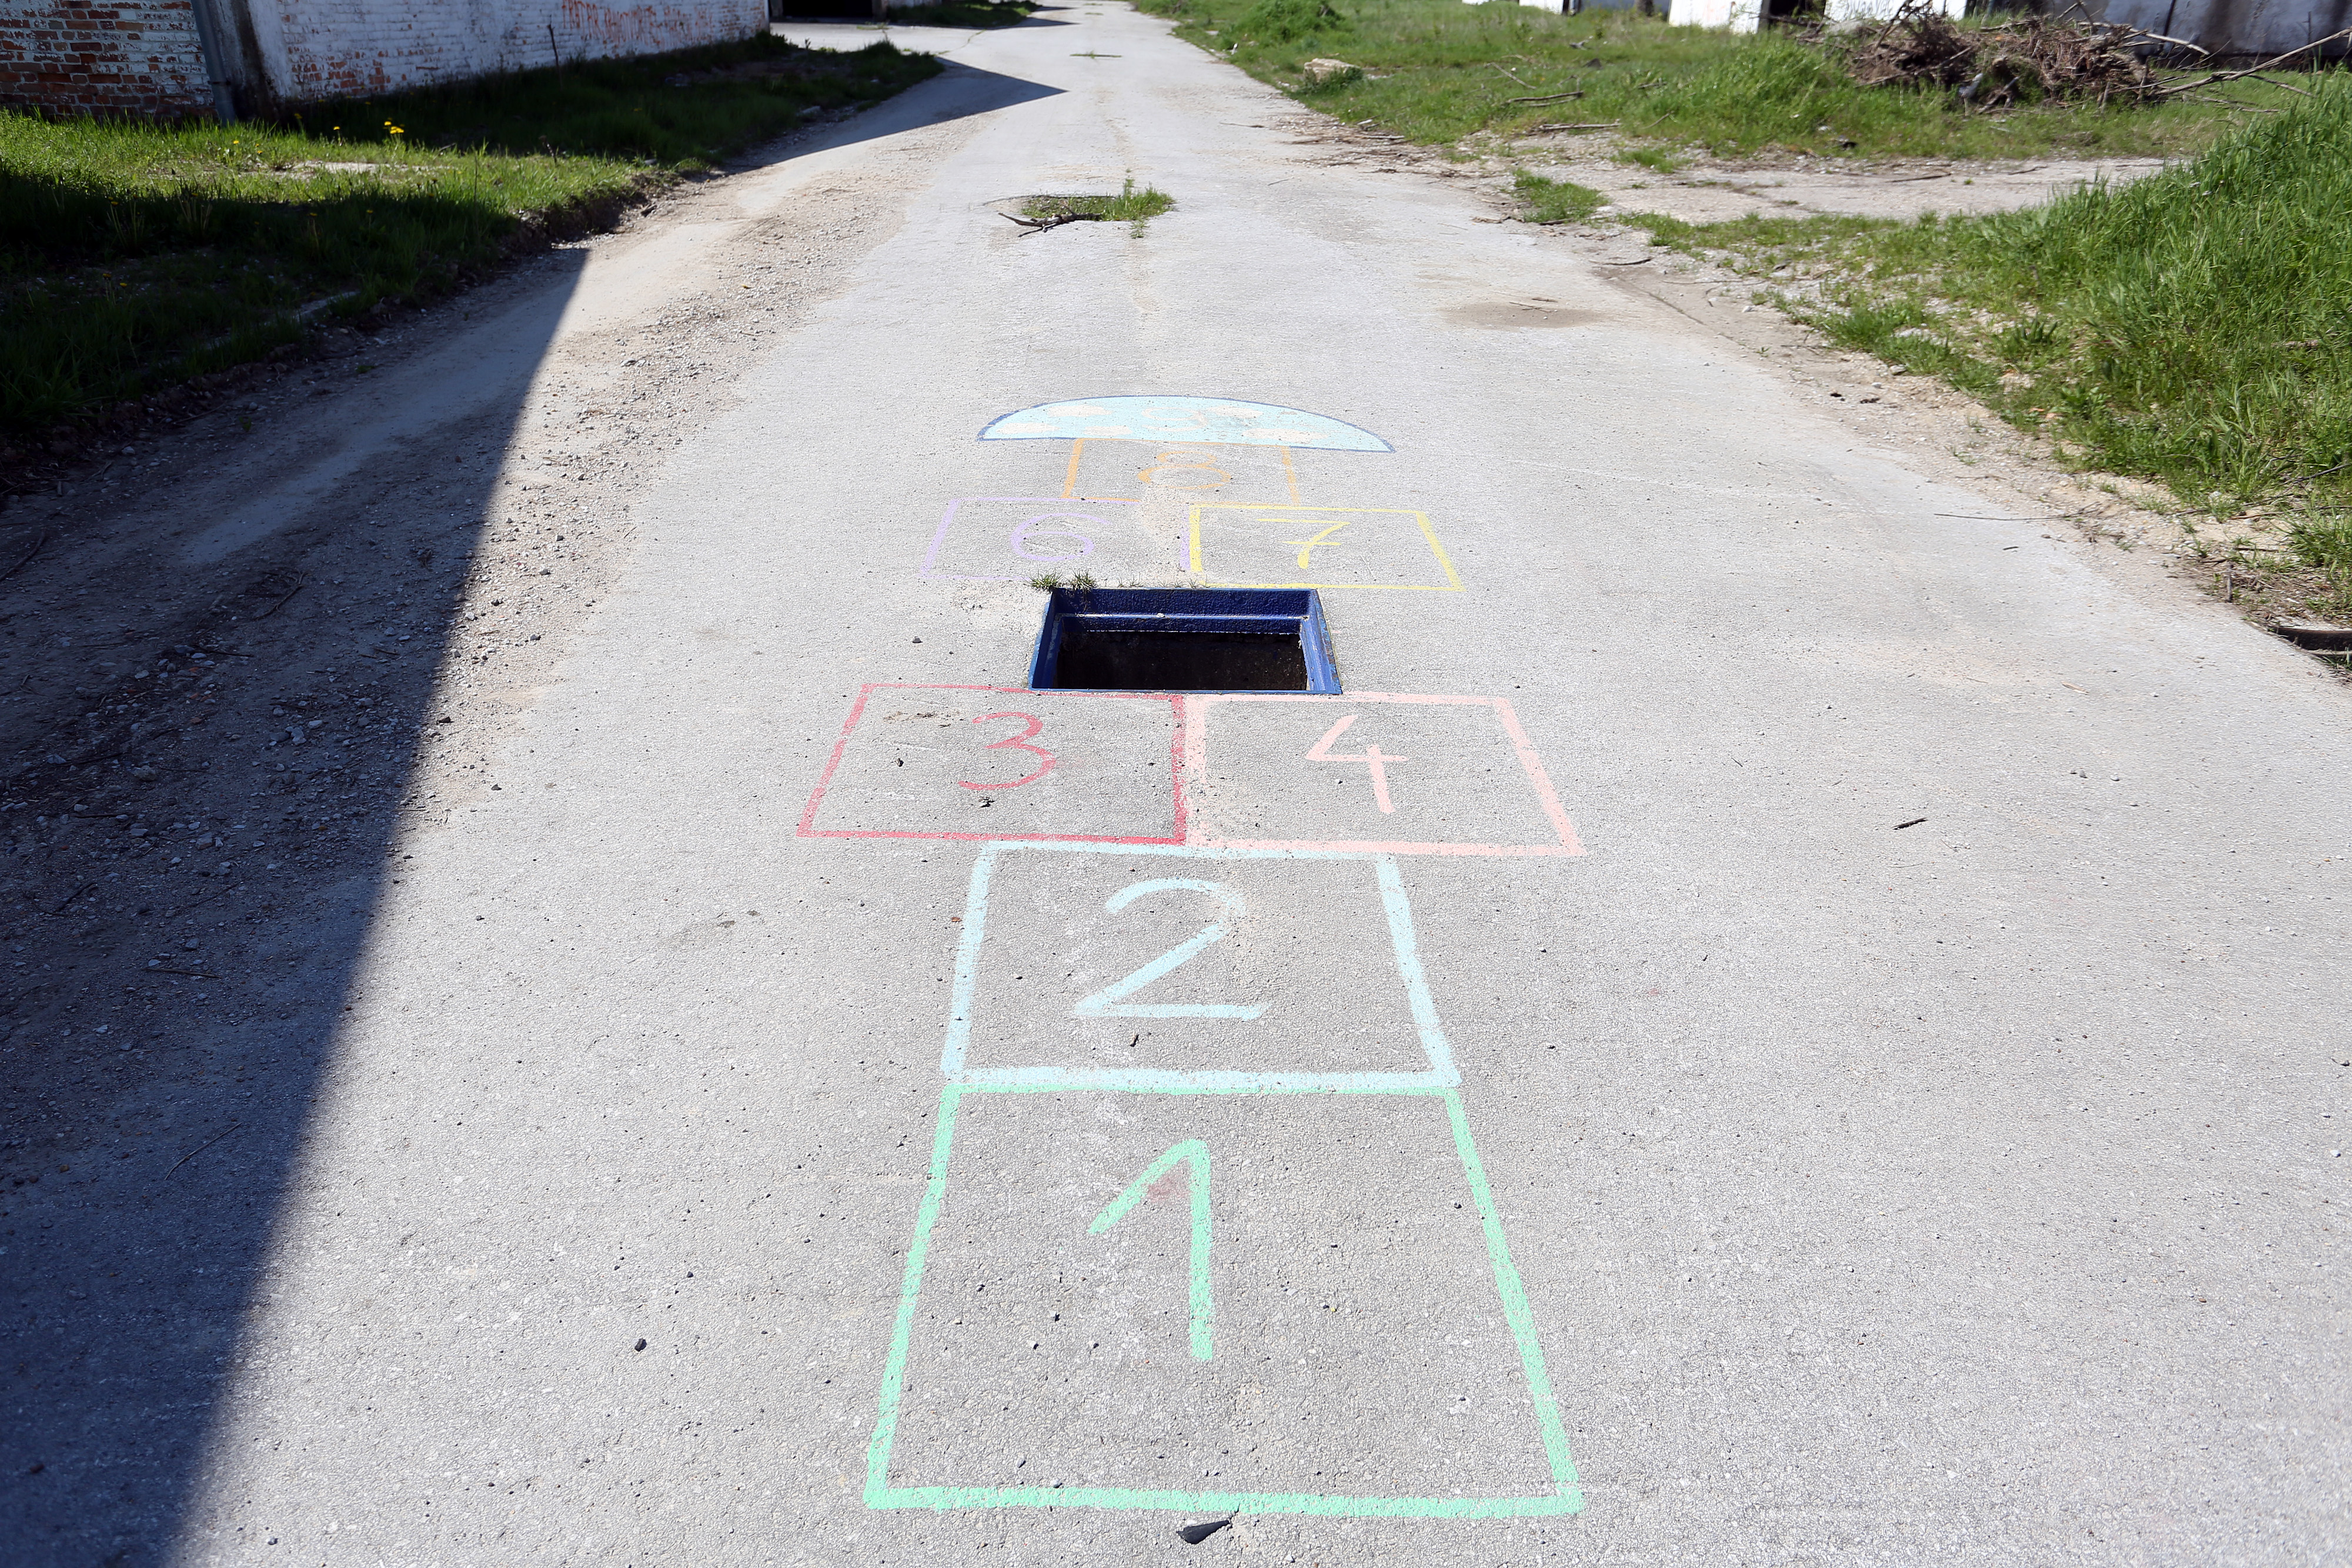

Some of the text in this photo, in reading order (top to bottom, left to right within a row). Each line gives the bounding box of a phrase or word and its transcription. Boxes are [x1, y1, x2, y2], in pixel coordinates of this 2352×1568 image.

[1137, 451, 1232, 490] 8
[1011, 513, 1111, 561] 6
[1256, 518, 1351, 569] 7
[958, 711, 1056, 791] 3
[1305, 714, 1409, 814] 4
[1074, 878, 1267, 1021] 2
[1087, 1138, 1213, 1362] 1
